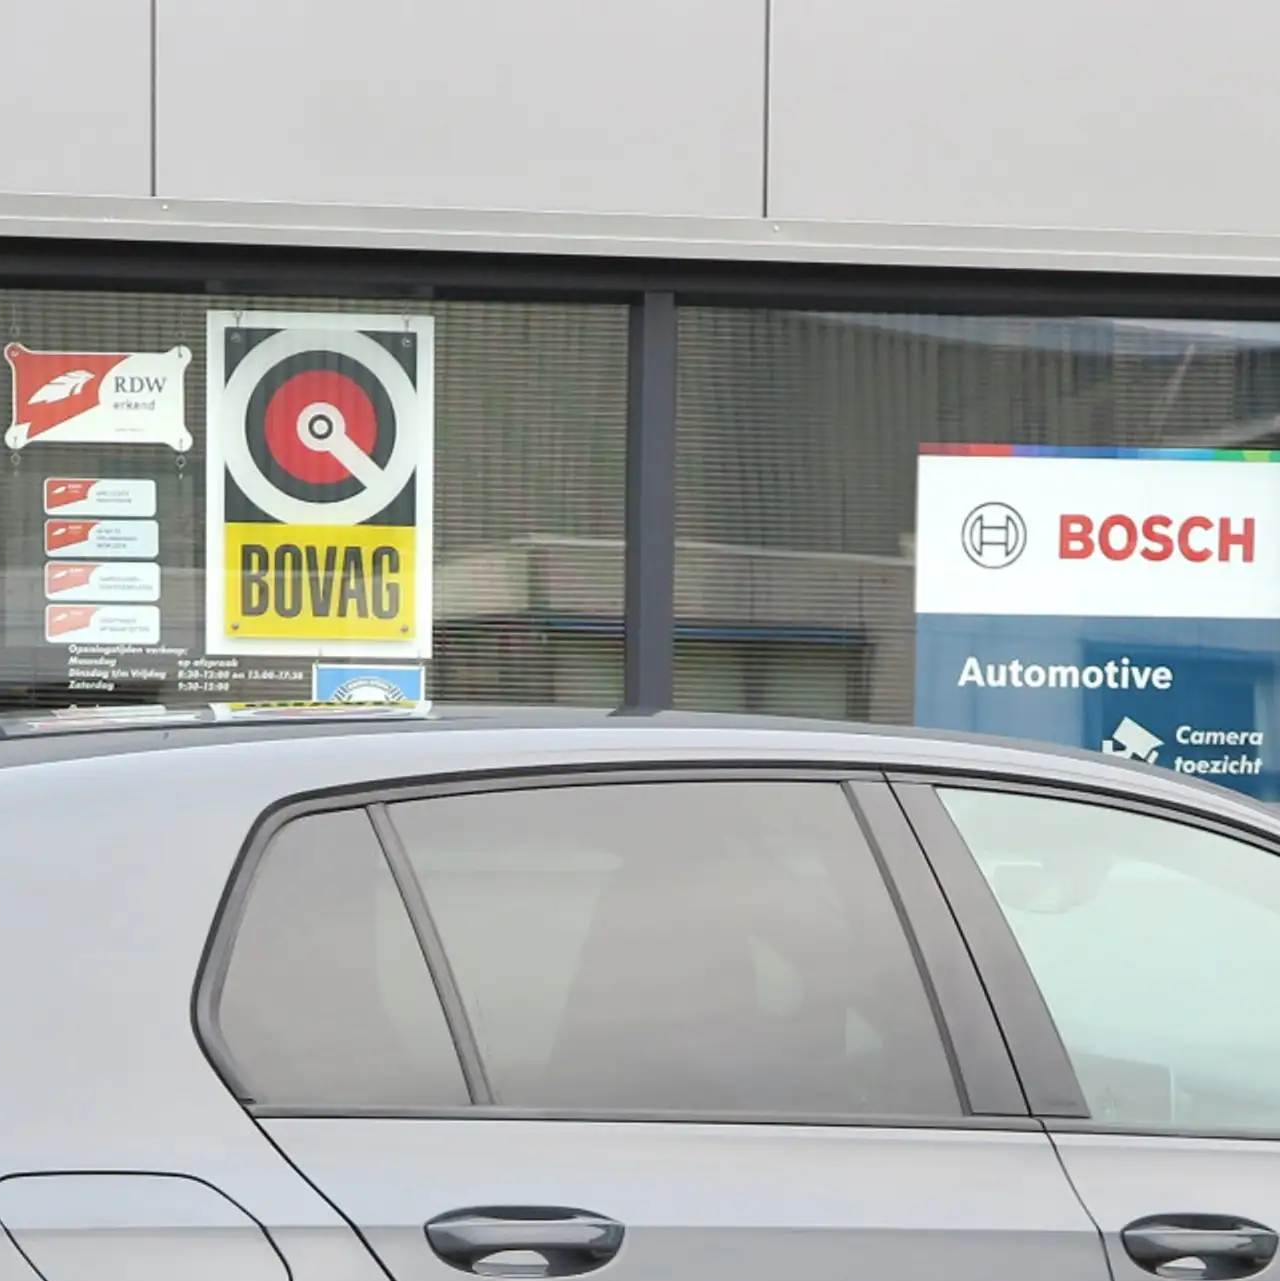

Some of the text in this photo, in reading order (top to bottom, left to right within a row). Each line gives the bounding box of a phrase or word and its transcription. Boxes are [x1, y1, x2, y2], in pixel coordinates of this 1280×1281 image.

[114, 375, 168, 394] RDW
[113, 398, 156, 412] erkend
[1058, 513, 1256, 563] BOSCH
[240, 543, 401, 619] BOVAG
[67, 656, 118, 668] Maandag
[67, 667, 109, 680] Dinsdag
[130, 667, 167, 681] Vrijdag
[957, 656, 1174, 691] Automotive
[67, 679, 115, 692] Zaterdag
[1175, 725, 1264, 746] Camera
[1174, 753, 1264, 776] toezicht
